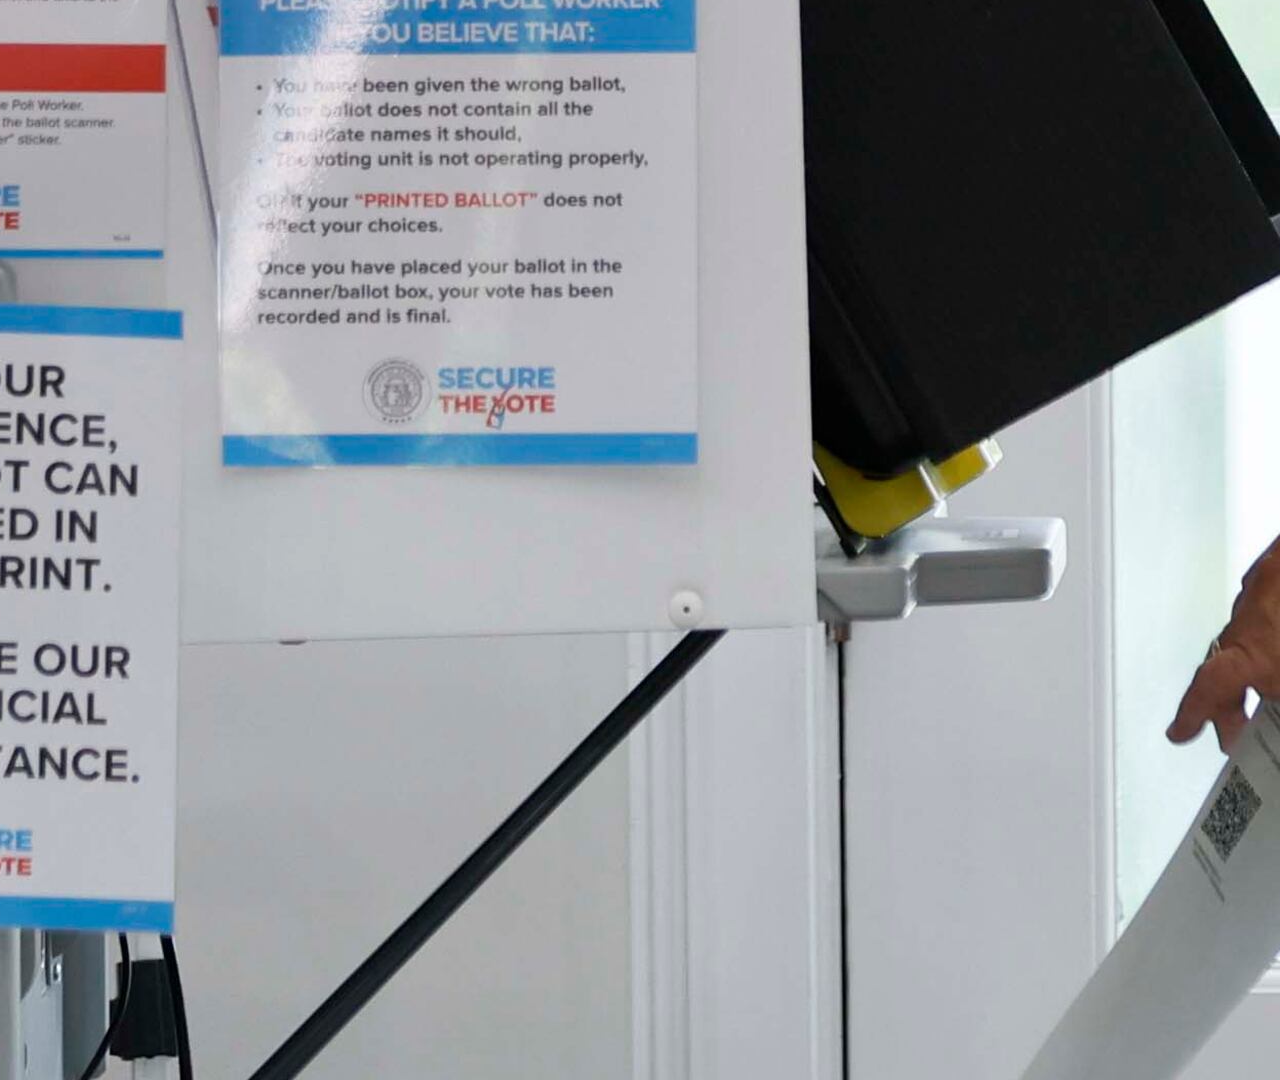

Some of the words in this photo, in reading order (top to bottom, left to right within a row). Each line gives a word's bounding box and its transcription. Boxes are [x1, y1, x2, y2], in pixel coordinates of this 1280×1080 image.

[417, 22, 518, 43] BELIEVE
[524, 22, 596, 44] THAT:
[363, 77, 408, 93] been
[414, 77, 465, 97] given
[470, 77, 500, 93] the
[505, 79, 563, 96] wrong
[570, 75, 625, 93] ballot,
[378, 101, 422, 117] does
[428, 102, 457, 117] not
[463, 101, 531, 117] contain
[537, 101, 558, 117] all
[563, 101, 593, 117] the
[371, 130, 431, 142] names
[437, 126, 449, 142] it
[455, 126, 521, 143] should,
[315, 151, 371, 171] voting
[378, 151, 413, 167] unit
[419, 151, 433, 167] is
[439, 152, 469, 167] not
[474, 150, 562, 169] operating
[569, 149, 648, 168] properly,
[308, 196, 348, 213] your
[543, 191, 587, 207] does
[593, 192, 622, 207] not
[321, 220, 362, 237] your
[368, 217, 442, 233] choices.
[258, 262, 306, 276] Once
[312, 263, 345, 279] you
[351, 259, 395, 275] have
[401, 259, 461, 279] placed
[468, 262, 508, 277] your
[515, 258, 565, 274] ballot
[571, 258, 587, 274] in
[593, 258, 622, 274] the
[258, 283, 389, 300] scanner/ballot
[395, 283, 433, 300] box,
[438, 286, 479, 302] your
[485, 284, 525, 299] vote
[531, 283, 563, 298] has
[569, 283, 613, 298] been
[258, 308, 340, 325] recorded
[346, 308, 380, 324] and
[387, 307, 401, 324] is
[406, 308, 450, 323] final.
[437, 367, 556, 389] SECURE
[438, 394, 486, 414] THE
[44, 461, 138, 497] CAN
[55, 509, 97, 544] IN
[34, 642, 130, 679] OUR
